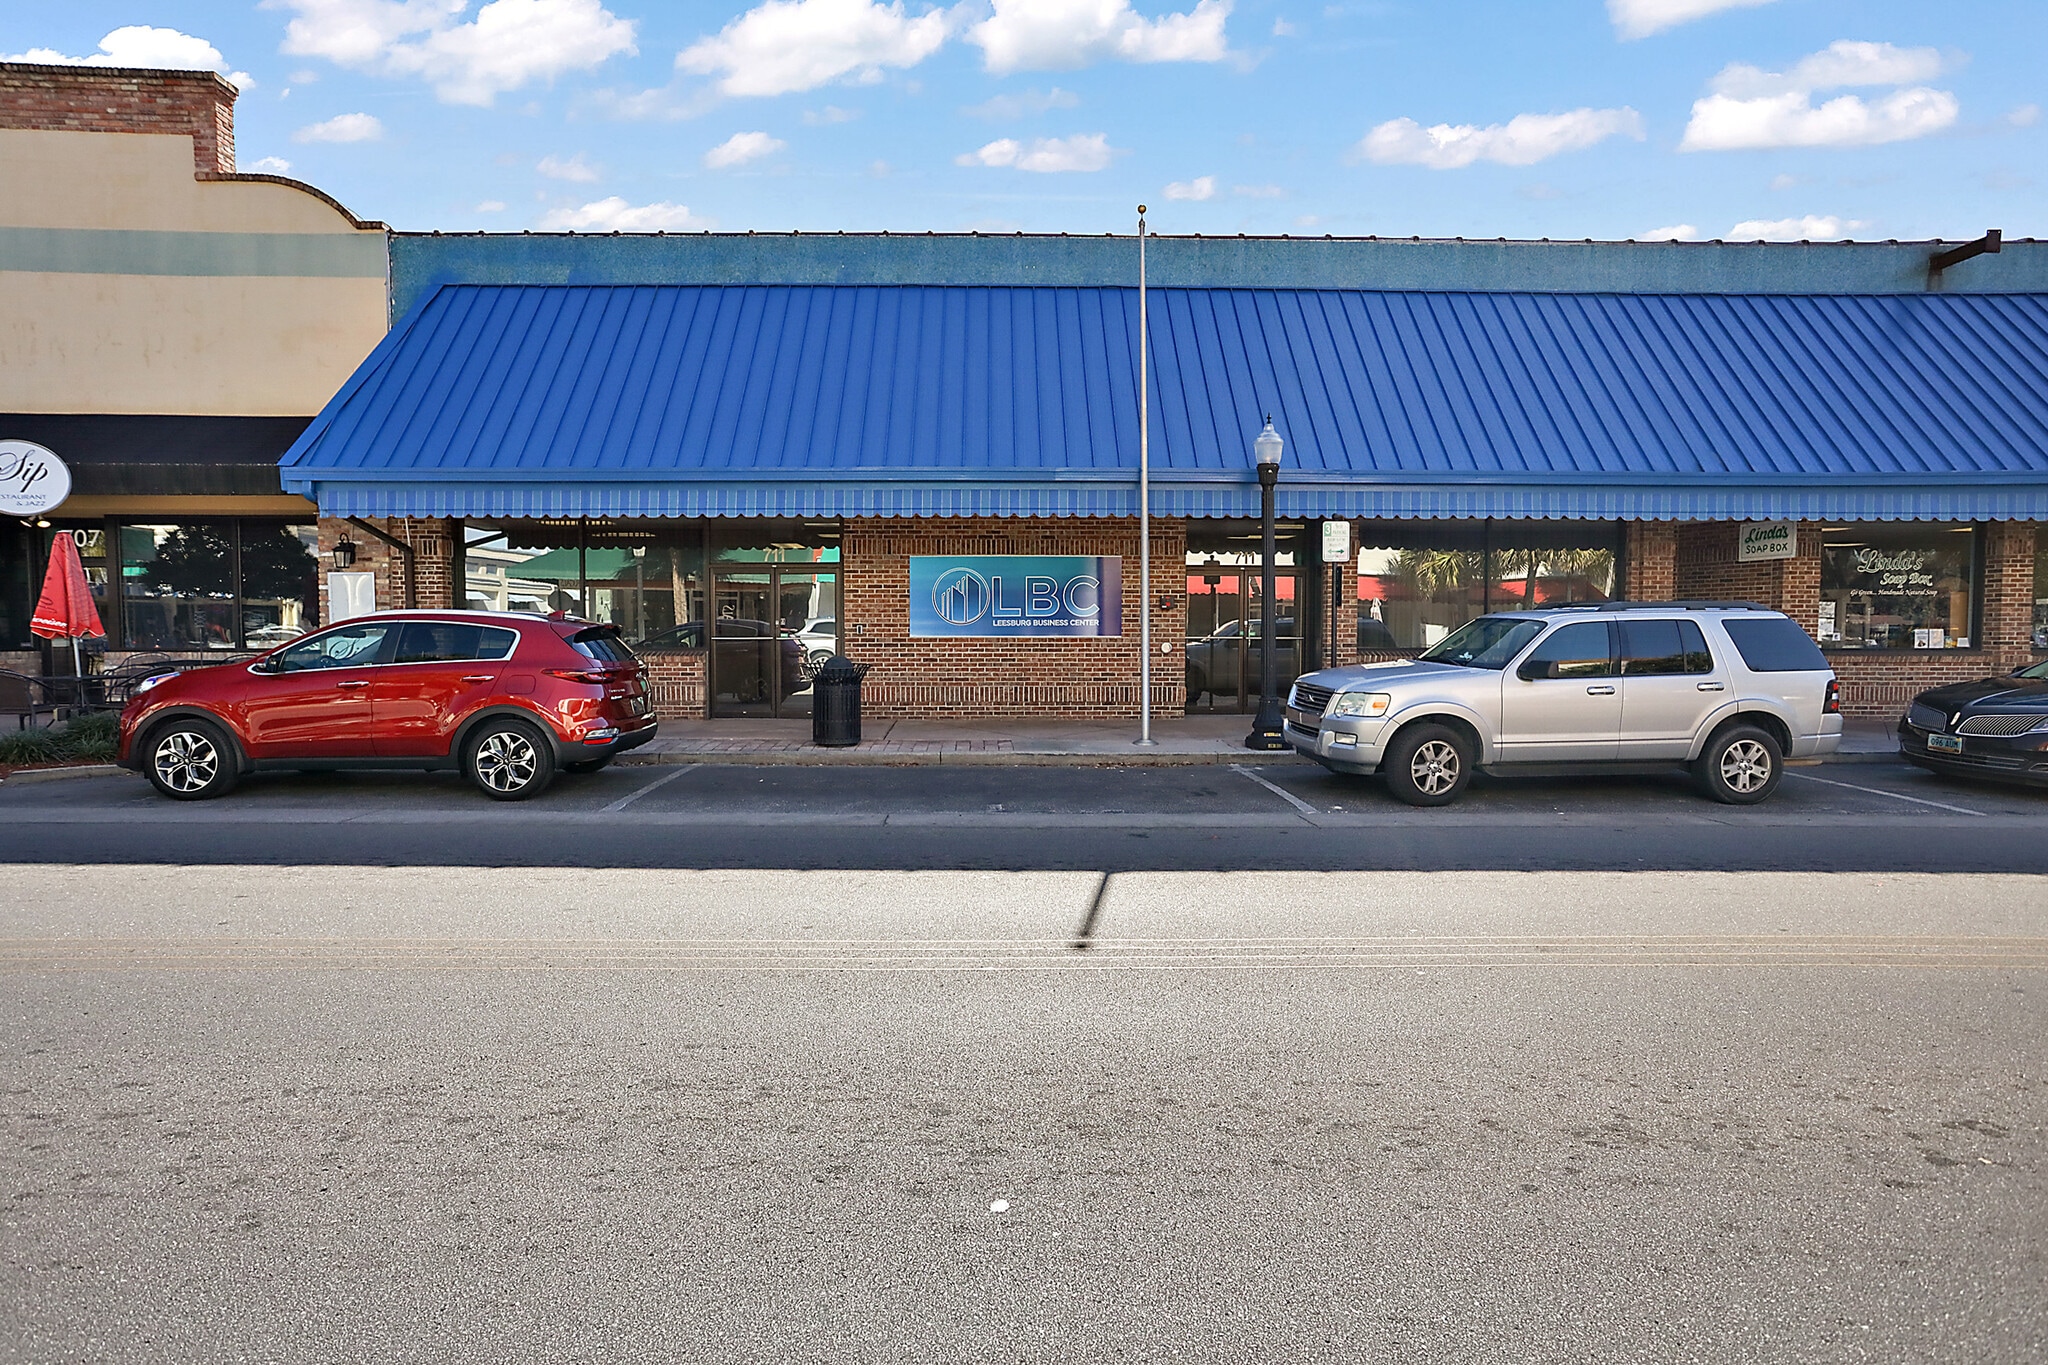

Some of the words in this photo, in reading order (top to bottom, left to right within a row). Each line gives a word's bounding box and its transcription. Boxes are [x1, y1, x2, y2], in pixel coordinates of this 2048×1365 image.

[0, 449, 48, 493] Sip
[1745, 525, 1789, 544] Linda's
[763, 548, 786, 562] 711
[1746, 544, 1769, 554] SOAP
[1769, 543, 1788, 553] BOX
[1234, 551, 1255, 564] 711
[1857, 548, 1925, 573] Linda's
[1880, 572, 1909, 588] Soap
[1909, 572, 1934, 587] Box
[991, 575, 1100, 617] LBC
[992, 619, 1032, 627] LEESBURG
[1032, 619, 1068, 627] BUSINESS
[1069, 619, 1100, 627] CENTER
